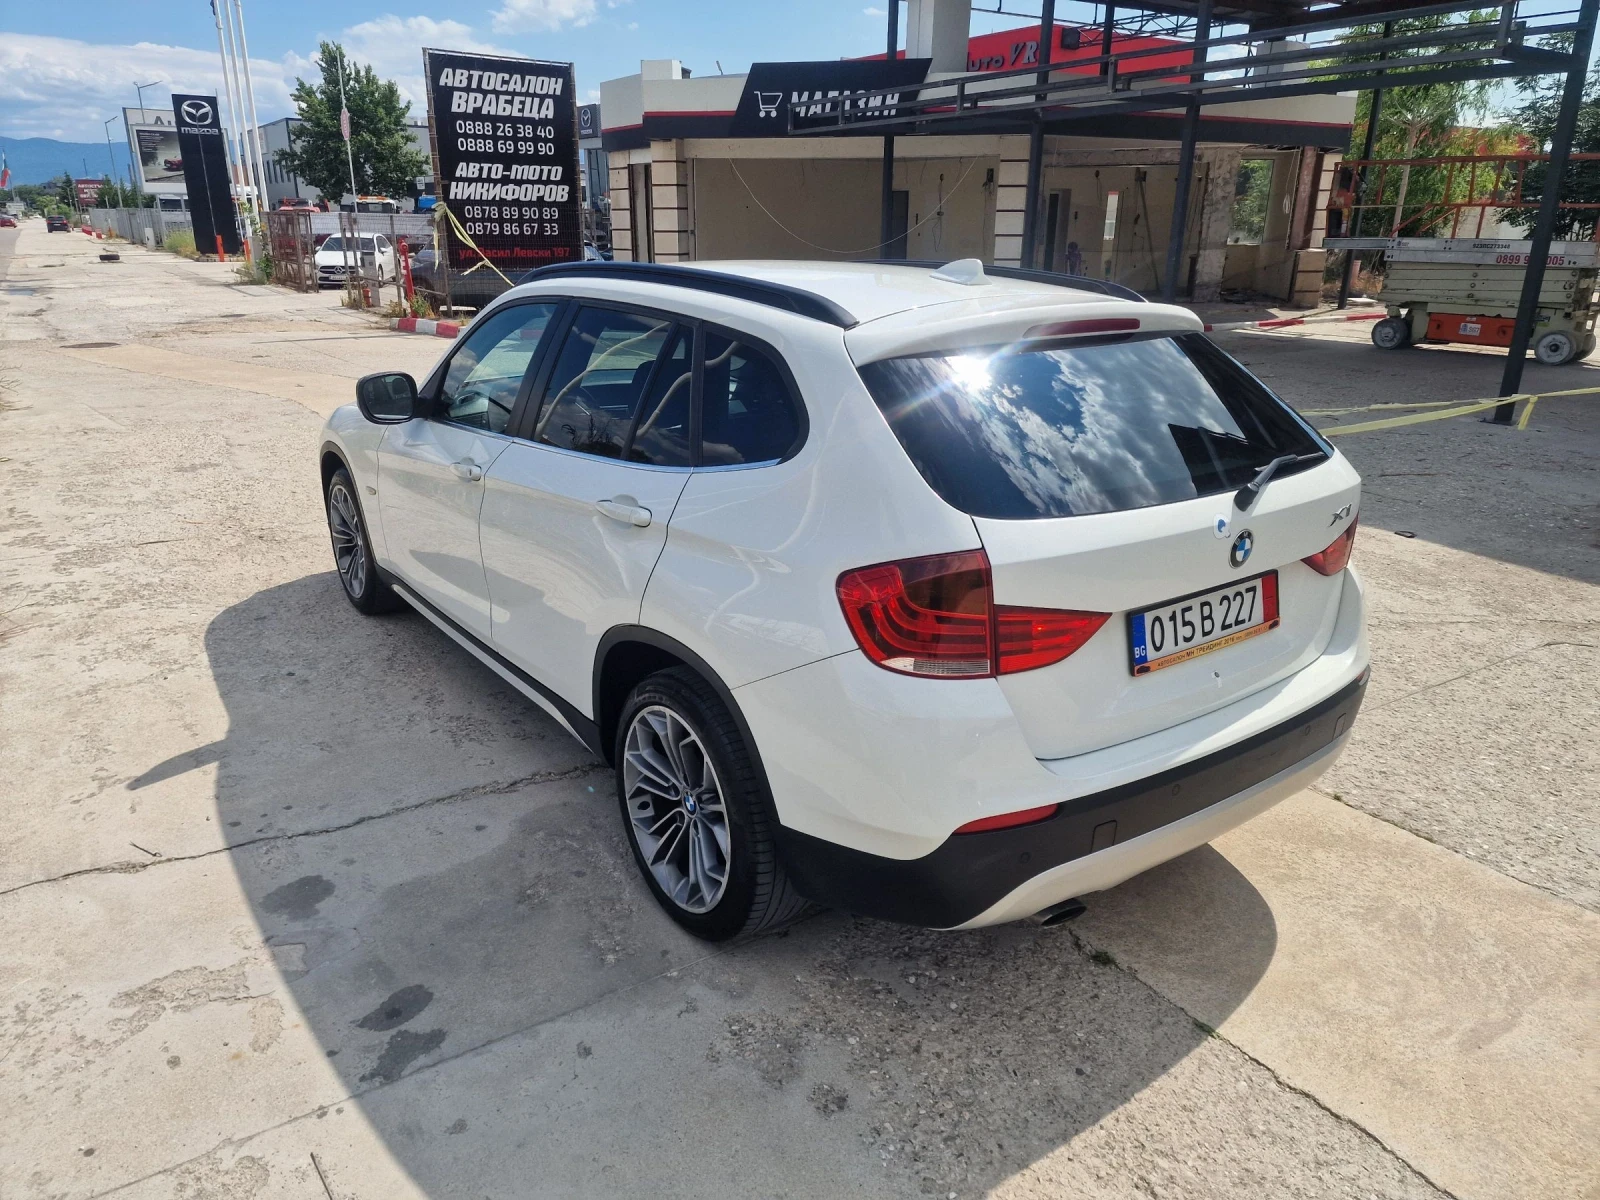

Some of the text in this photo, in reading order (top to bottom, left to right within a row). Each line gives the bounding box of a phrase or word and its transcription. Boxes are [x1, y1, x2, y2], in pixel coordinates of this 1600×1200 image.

[439, 68, 563, 95] АВТОСАЛОН
[451, 91, 554, 120] ВРАБЕЦА
[456, 121, 554, 138] 0888 26 38 40
[458, 138, 554, 155] 0888 69 99 90
[455, 162, 563, 181] АВТО-МОТО
[450, 182, 570, 202] НИКИФОРОВ
[465, 206, 558, 219] 0878 89 90 89
[466, 222, 558, 235] 0879 86 67 33
[460, 249, 475, 259] ул.
[513, 247, 551, 257] Левски
[553, 247, 570, 256] 197
[1496, 255, 1520, 264] 0899
[1134, 646, 1146, 658] BG
